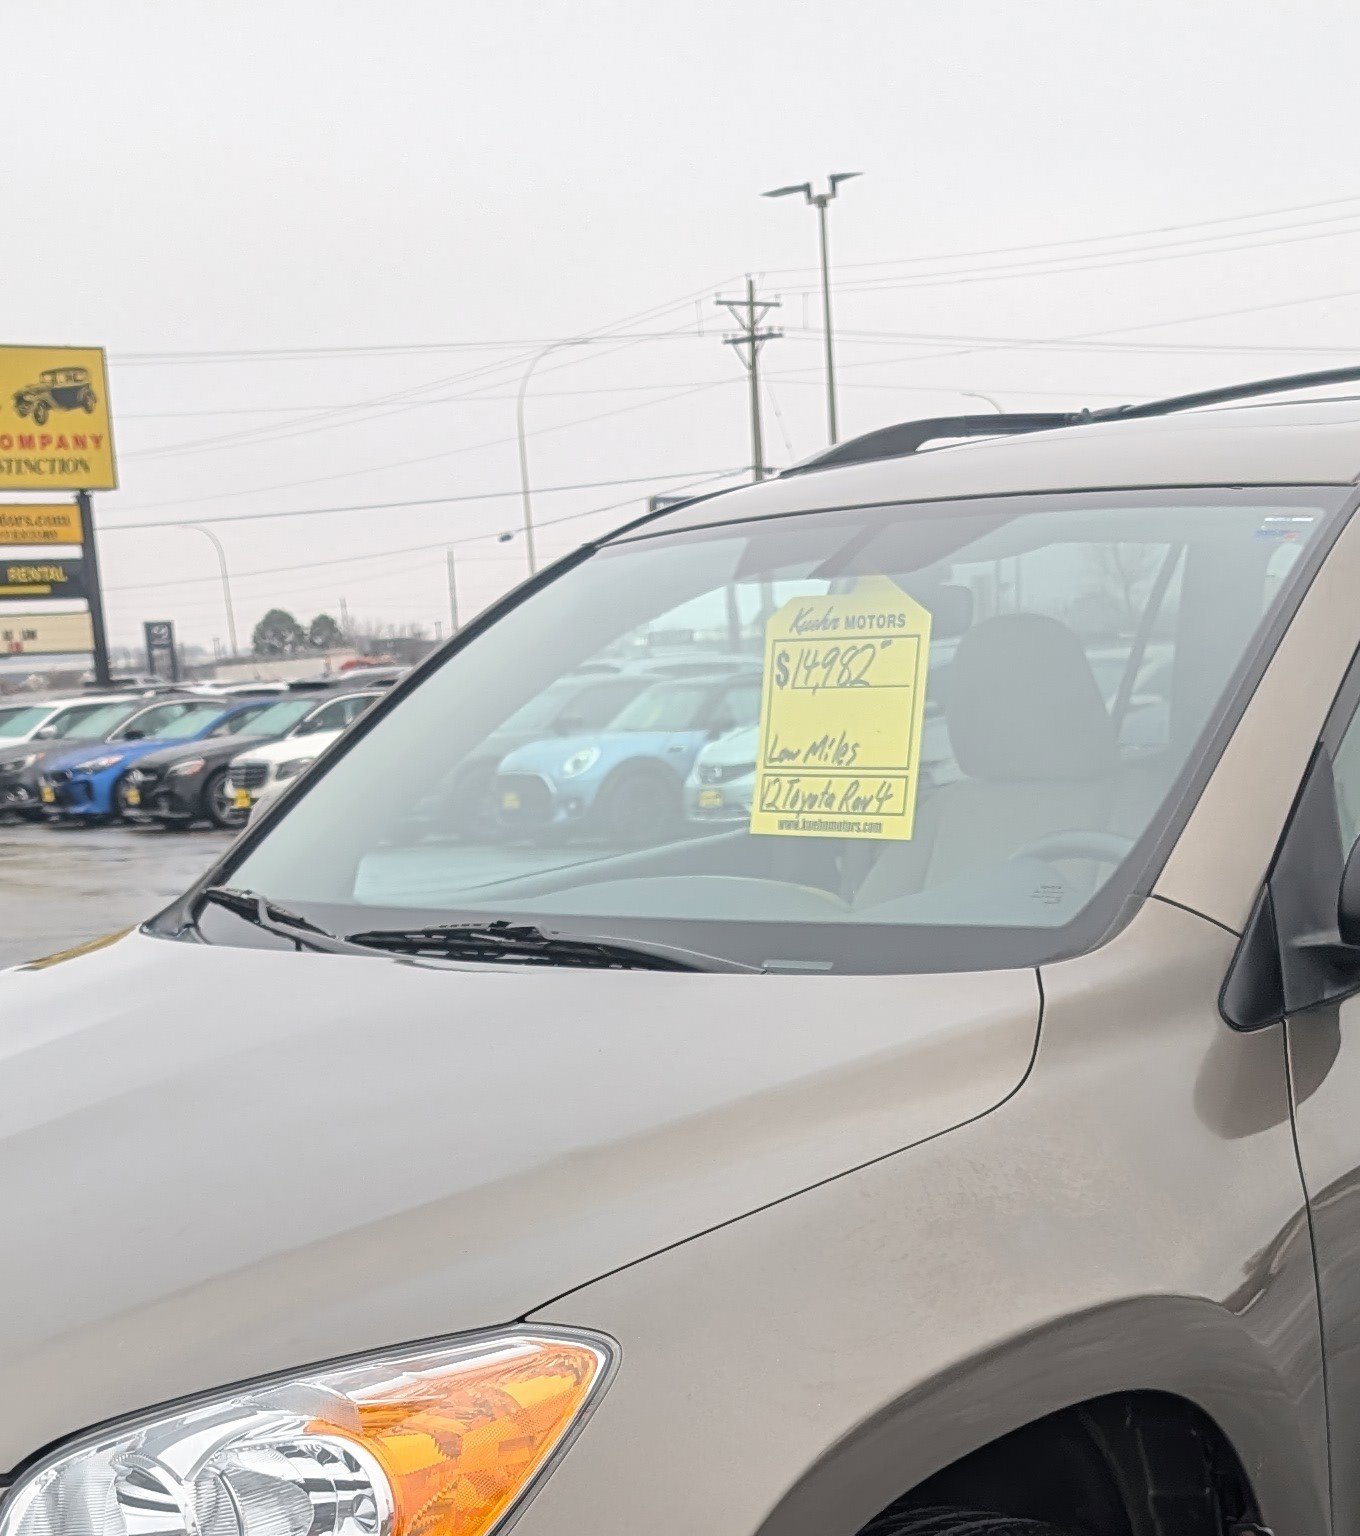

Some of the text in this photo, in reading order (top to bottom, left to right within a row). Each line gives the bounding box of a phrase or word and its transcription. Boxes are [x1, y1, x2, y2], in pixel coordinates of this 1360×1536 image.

[844, 613, 907, 630] MOTORS
[769, 730, 861, 766] Low Miles
[783, 778, 836, 820] Toyota
